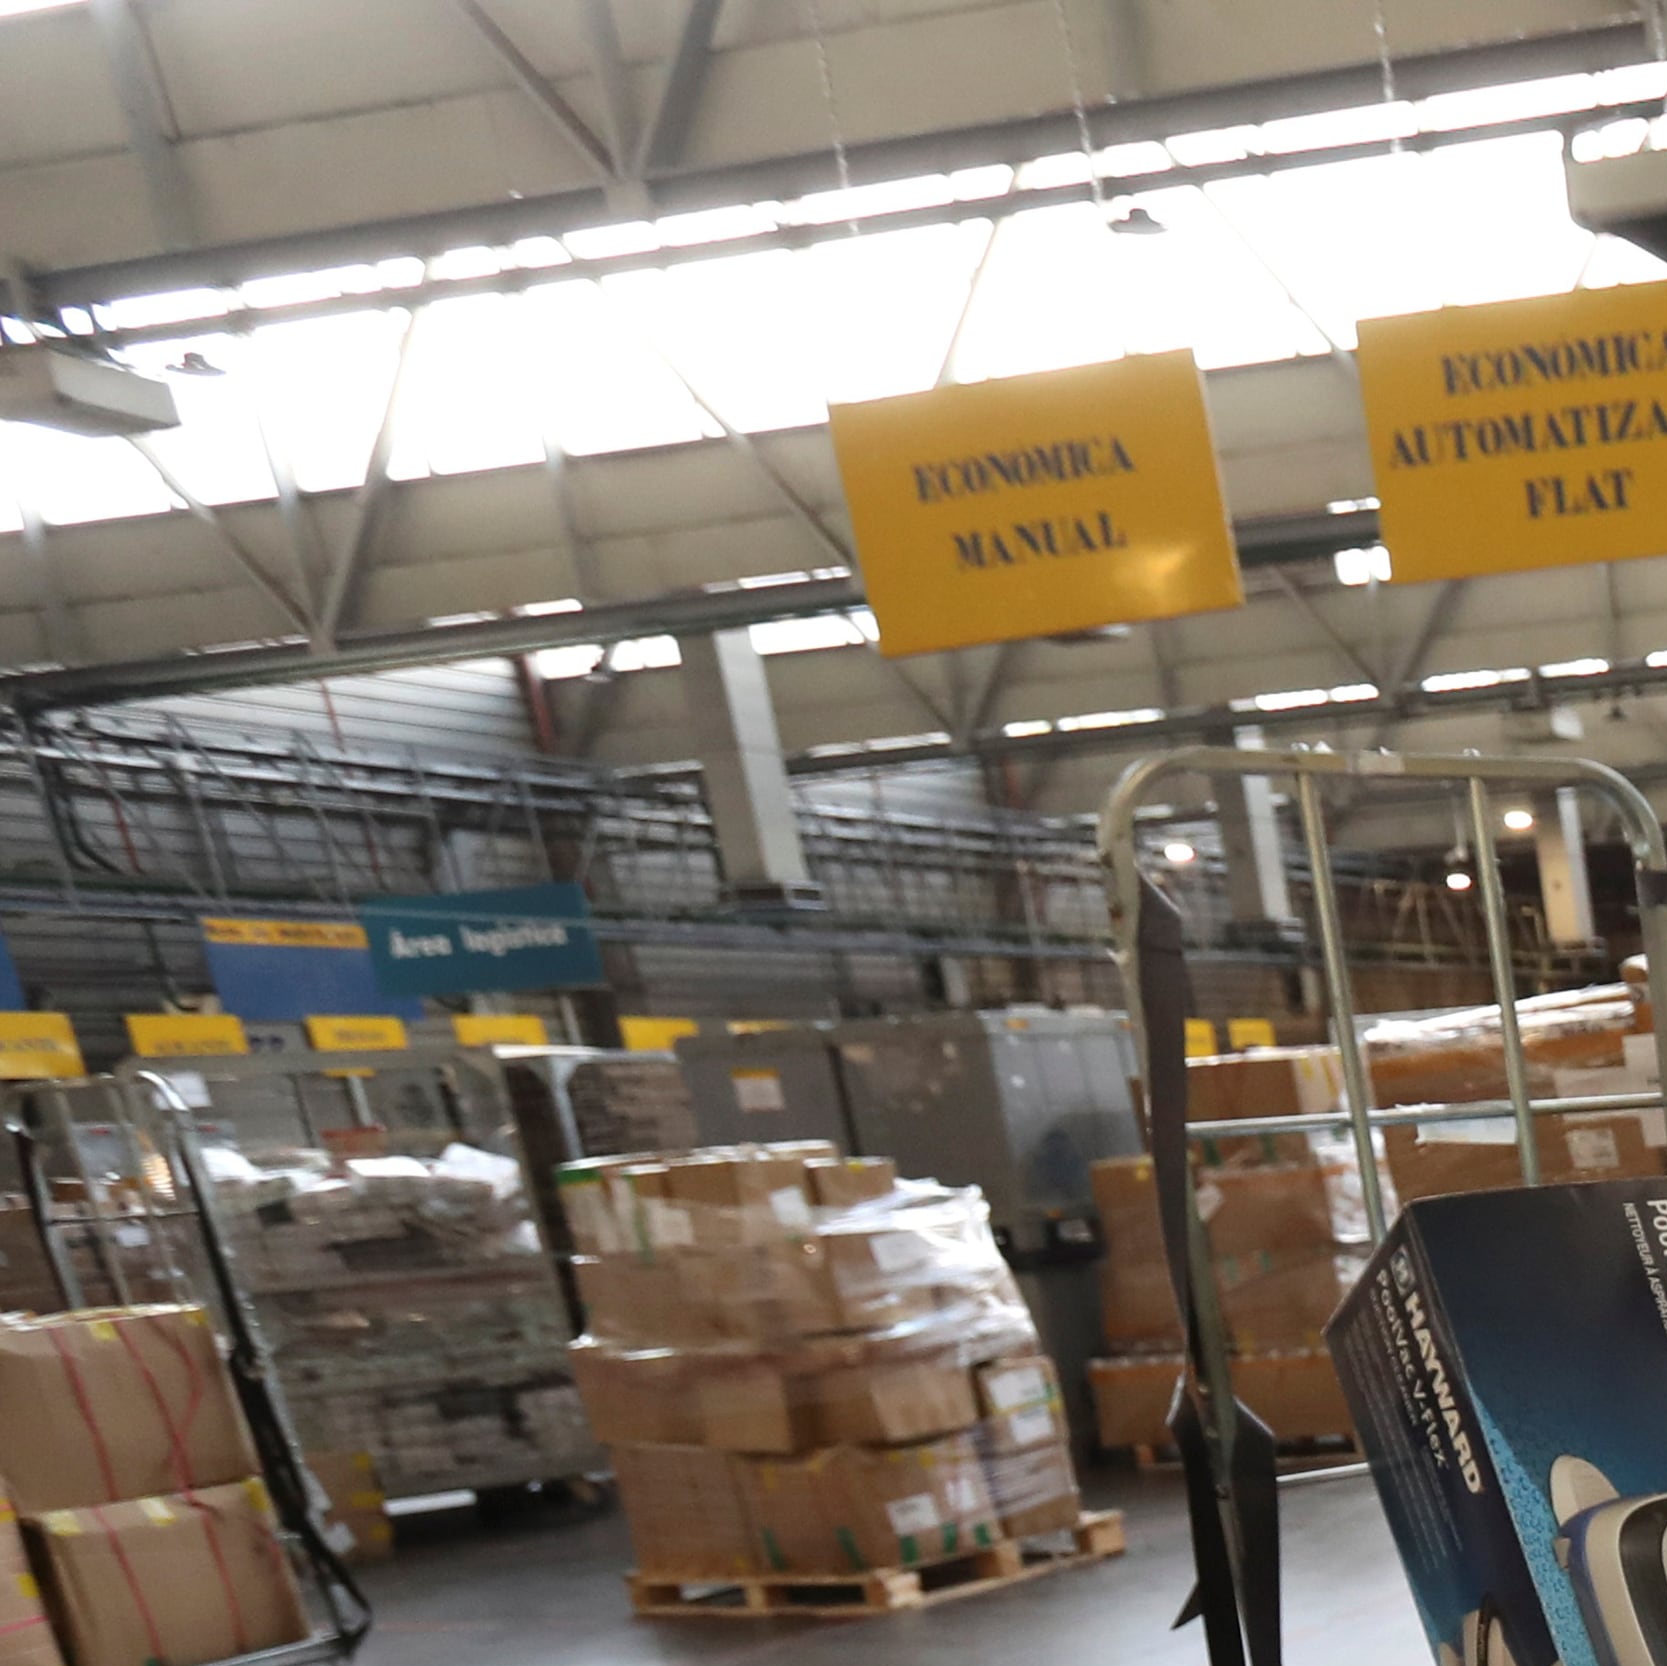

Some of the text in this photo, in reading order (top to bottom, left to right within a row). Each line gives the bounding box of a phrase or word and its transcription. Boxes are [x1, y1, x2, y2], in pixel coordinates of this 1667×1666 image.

[1524, 470, 1634, 521] FLAT
[954, 511, 1128, 573] MANUAL
[1623, 1202, 1655, 1265] NETTOYEUR
[1404, 1291, 1485, 1495] HAYWARD
